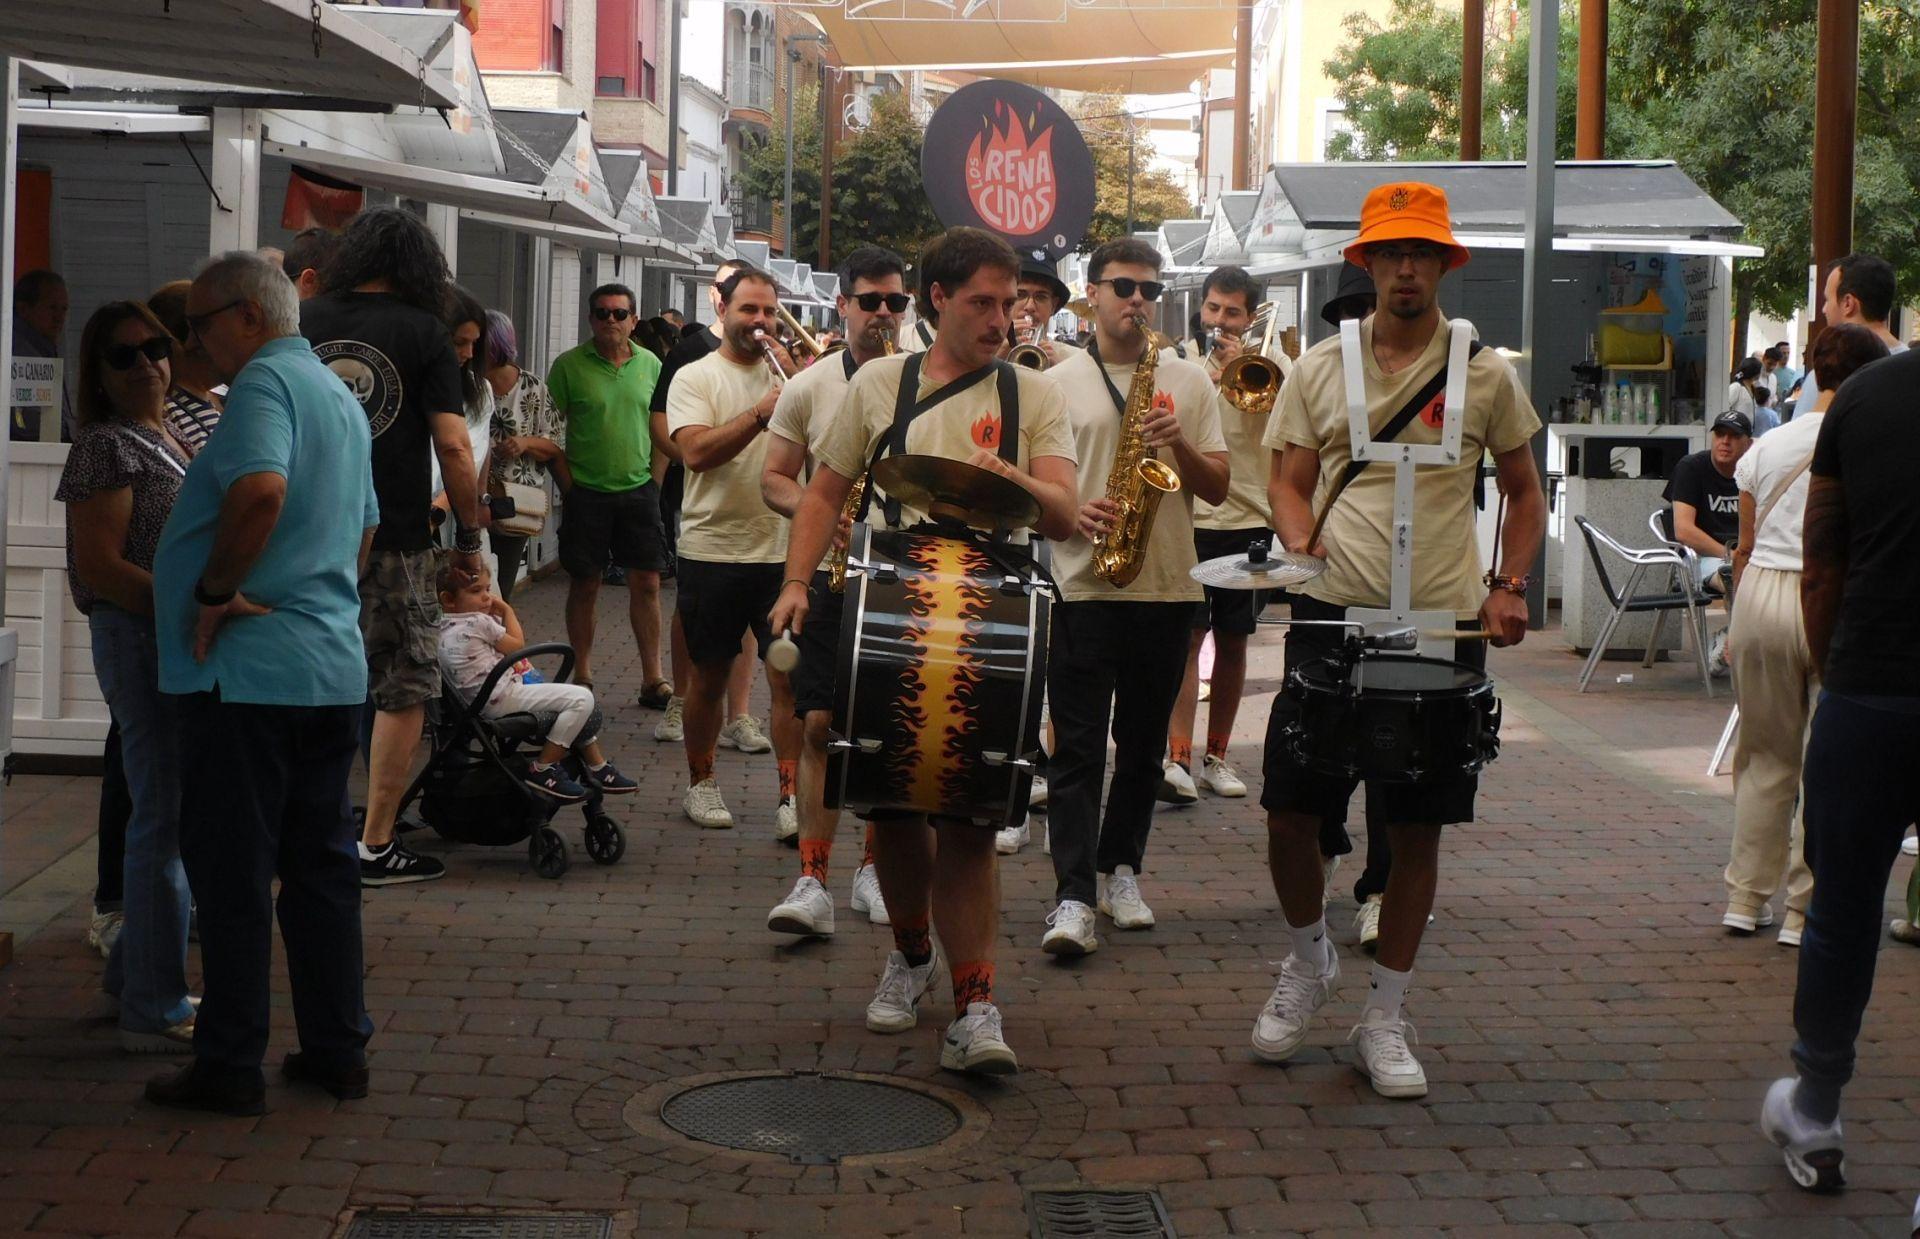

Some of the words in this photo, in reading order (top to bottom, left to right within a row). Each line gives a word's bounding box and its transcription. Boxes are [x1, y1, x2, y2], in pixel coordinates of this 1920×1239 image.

[970, 157, 983, 189] LOS
[985, 149, 1051, 192] RENA
[979, 184, 1051, 230] CIDOS
[370, 412, 390, 433] ORI
[1431, 402, 1445, 423] R
[982, 425, 994, 443] R
[1708, 494, 1739, 513] VAN
[544, 778, 557, 788] N
[604, 774, 615, 783] N
